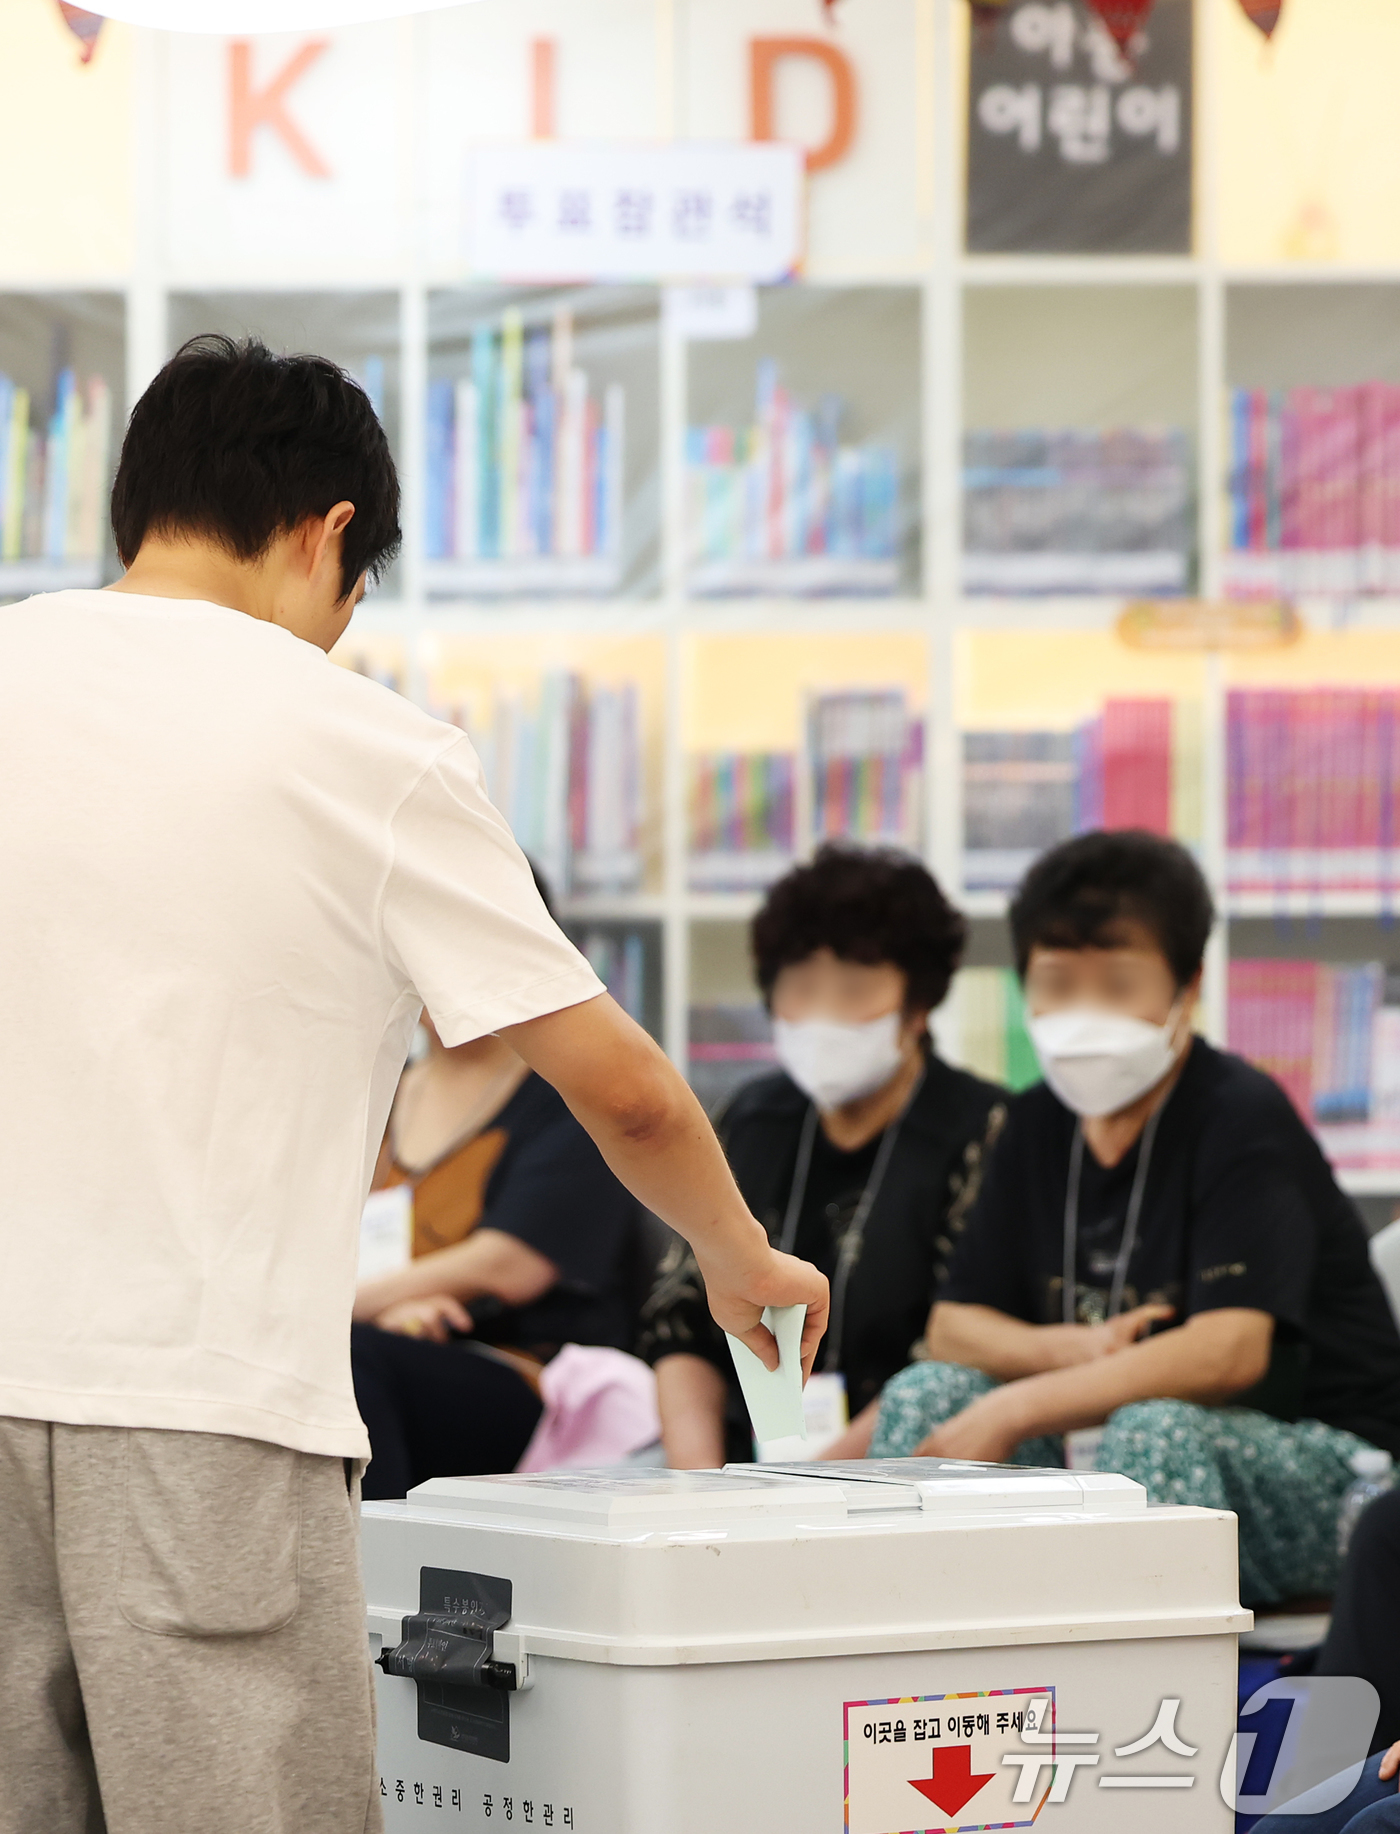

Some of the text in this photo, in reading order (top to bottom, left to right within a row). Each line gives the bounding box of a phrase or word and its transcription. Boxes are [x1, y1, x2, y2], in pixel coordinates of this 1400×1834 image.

[977, 83, 1181, 163] 어린이
[863, 1709, 1038, 1744] 이곳을 잡고 이동해 주세요
[482, 1793, 575, 1831] 공정한관리
